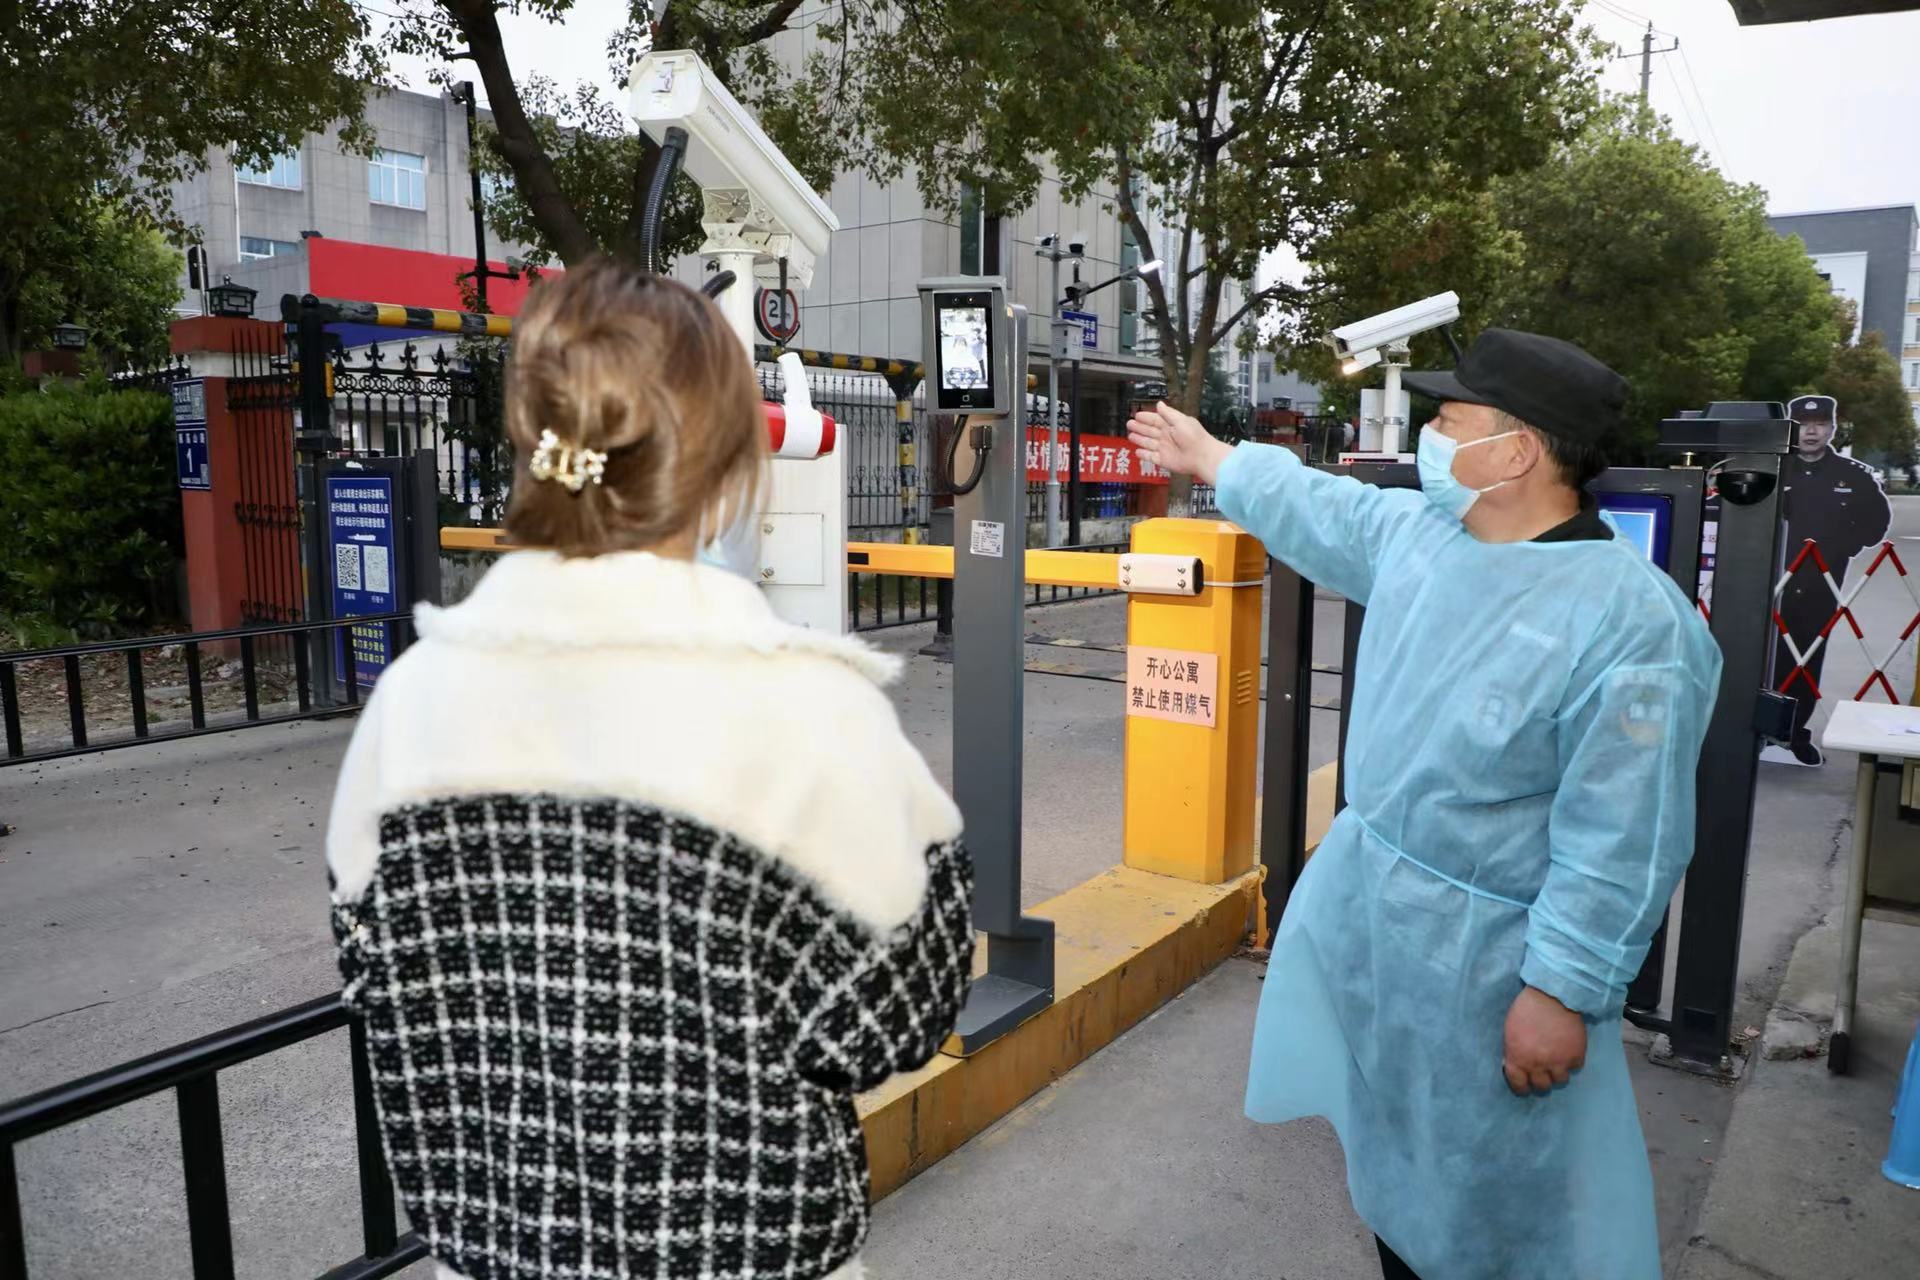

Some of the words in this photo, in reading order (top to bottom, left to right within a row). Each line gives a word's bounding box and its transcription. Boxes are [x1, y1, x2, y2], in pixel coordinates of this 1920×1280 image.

[186, 451, 193, 473] 1
[1146, 657, 1199, 684] 开心公寓
[1132, 686, 1211, 718] 禁止使用煤气
